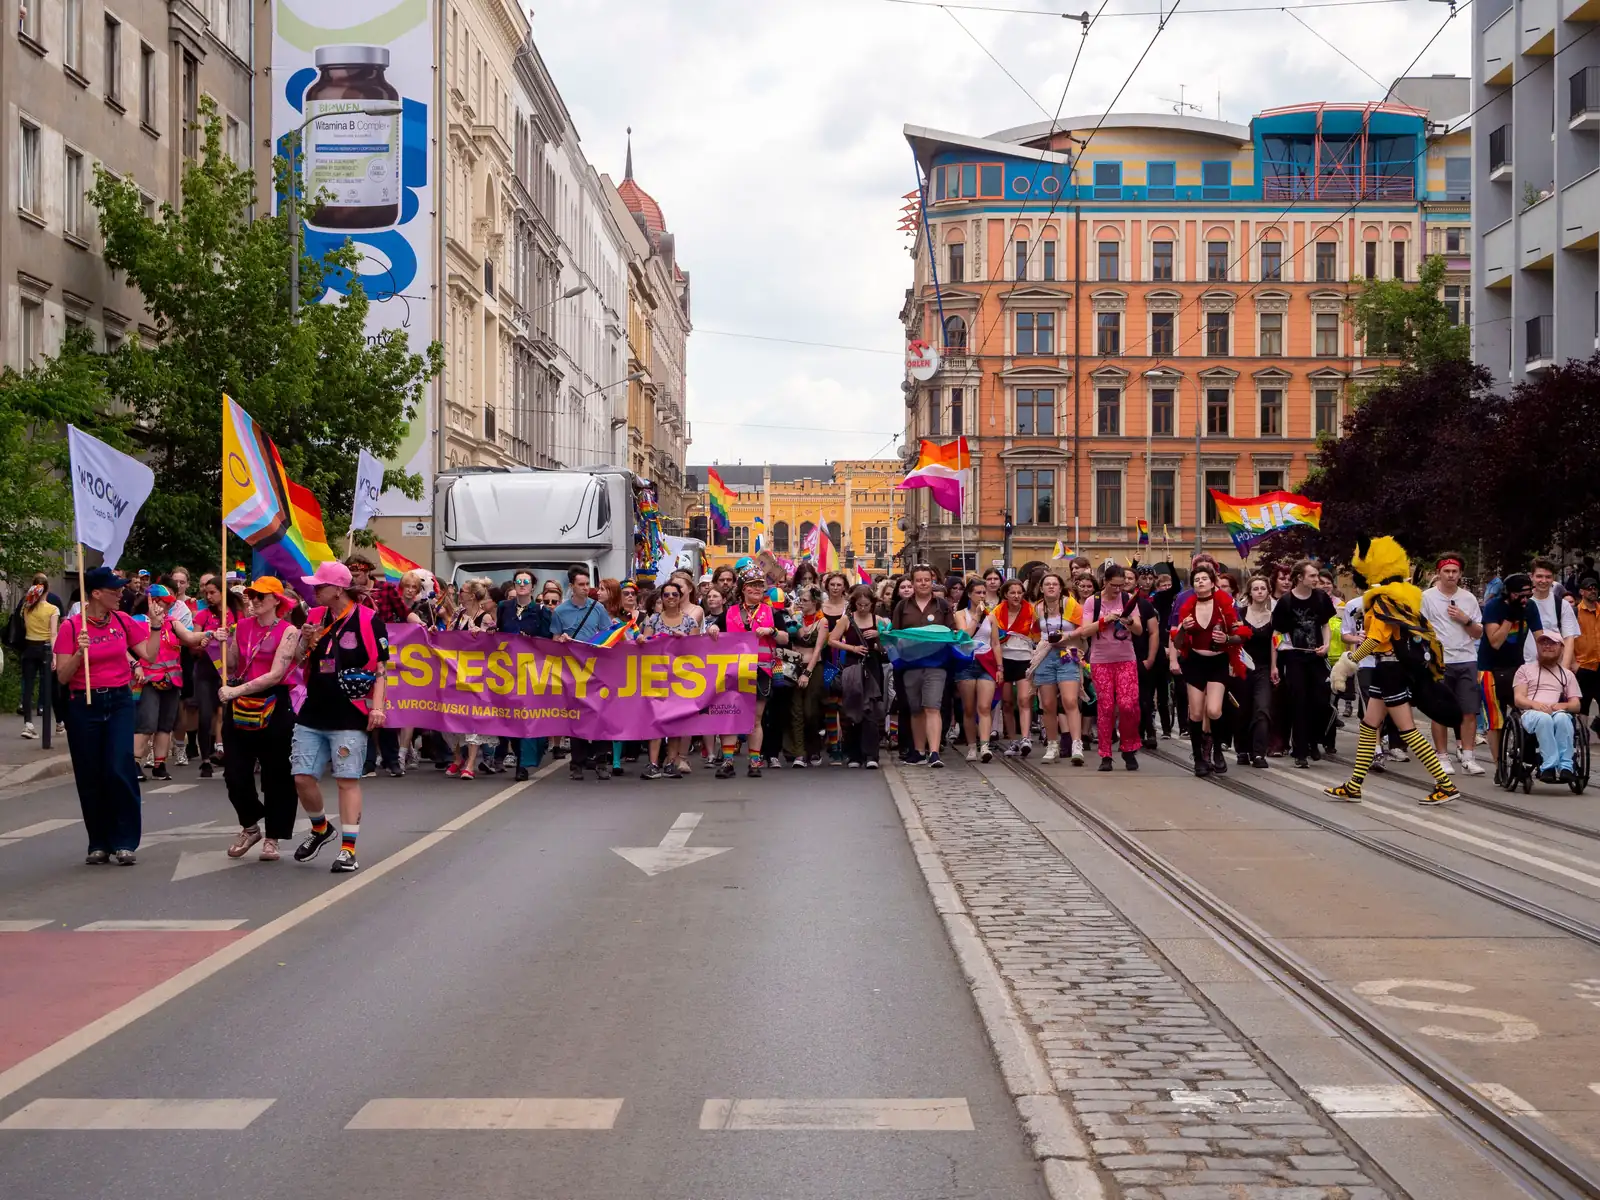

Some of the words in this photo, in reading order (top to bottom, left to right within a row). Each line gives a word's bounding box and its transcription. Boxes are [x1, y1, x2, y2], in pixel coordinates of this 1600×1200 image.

[315, 121, 348, 130] Witamina
[349, 121, 355, 130] B
[906, 359, 931, 369] ORLEN
[77, 465, 129, 518] WROCW
[386, 641, 610, 699] ESTEŚMY.
[617, 653, 758, 699] JESTE
[471, 705, 511, 719] MARSZ
[513, 706, 581, 720] RÓWNOŚCI
